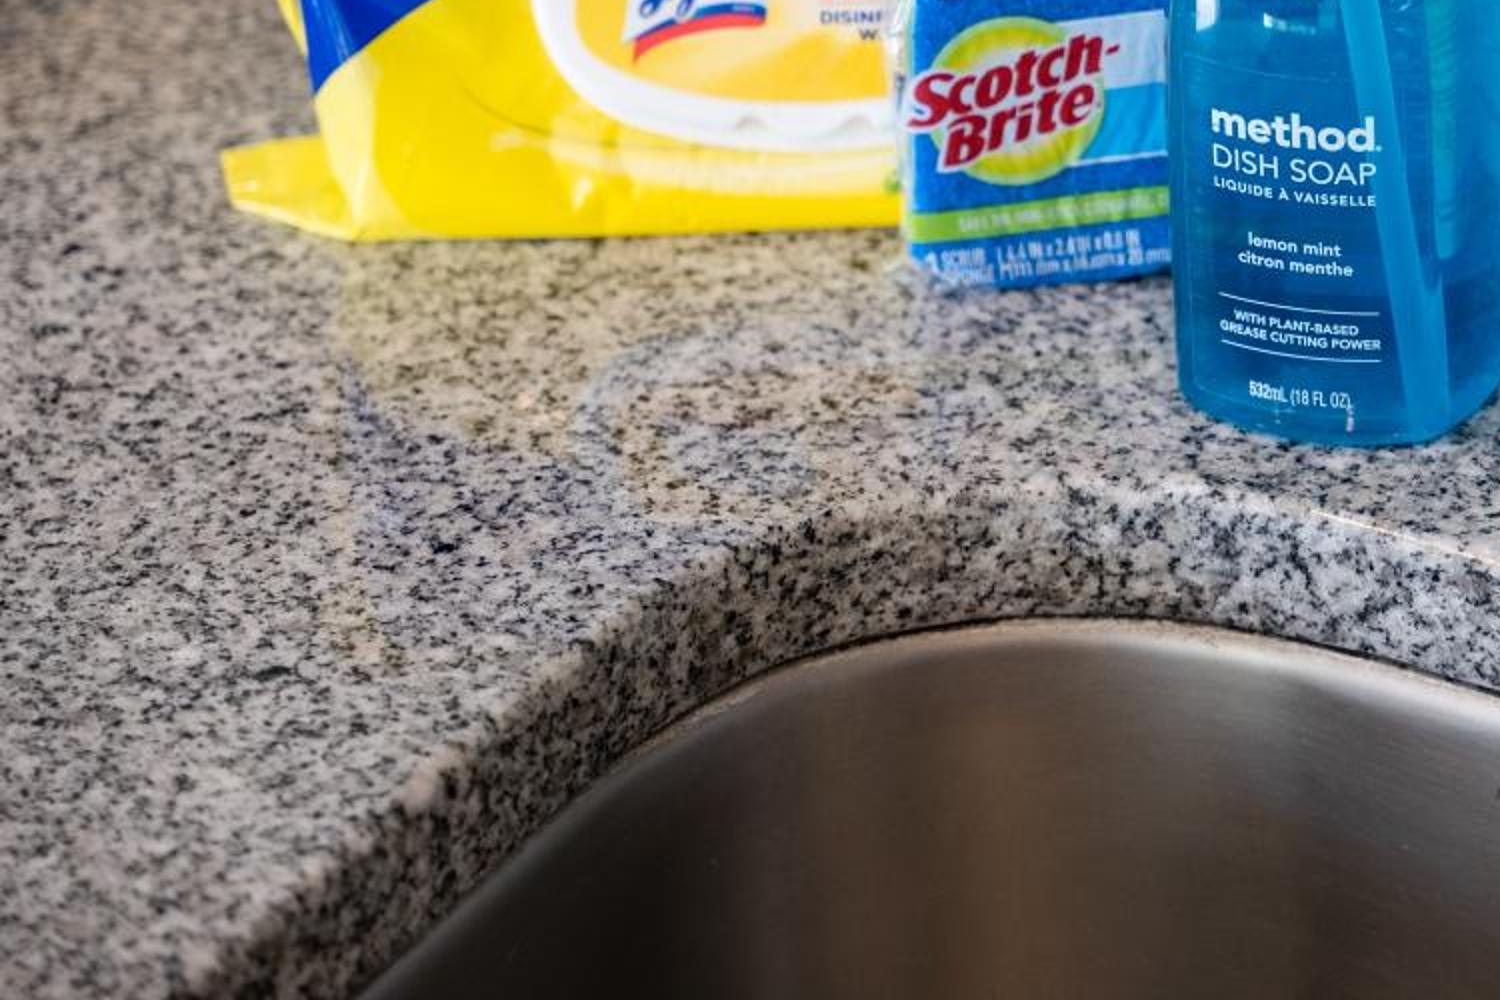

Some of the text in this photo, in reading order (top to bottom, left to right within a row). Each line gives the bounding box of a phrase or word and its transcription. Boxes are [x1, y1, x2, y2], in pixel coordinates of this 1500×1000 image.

[908, 34, 1120, 127] Scotch-
[943, 84, 1095, 168] Brite
[1213, 143, 1376, 185] DISH SOAP
[1214, 176, 1376, 207] LIQUIDE À VAISSELLE
[1248, 232, 1342, 257] lemon mint
[1238, 251, 1353, 277] citron menthe
[1220, 319, 1381, 350] GREASE CUTTING POWER
[1234, 308, 1359, 336] WITH PLANT-BASED
[1290, 388, 1309, 406] (18
[1312, 390, 1327, 407] FL
